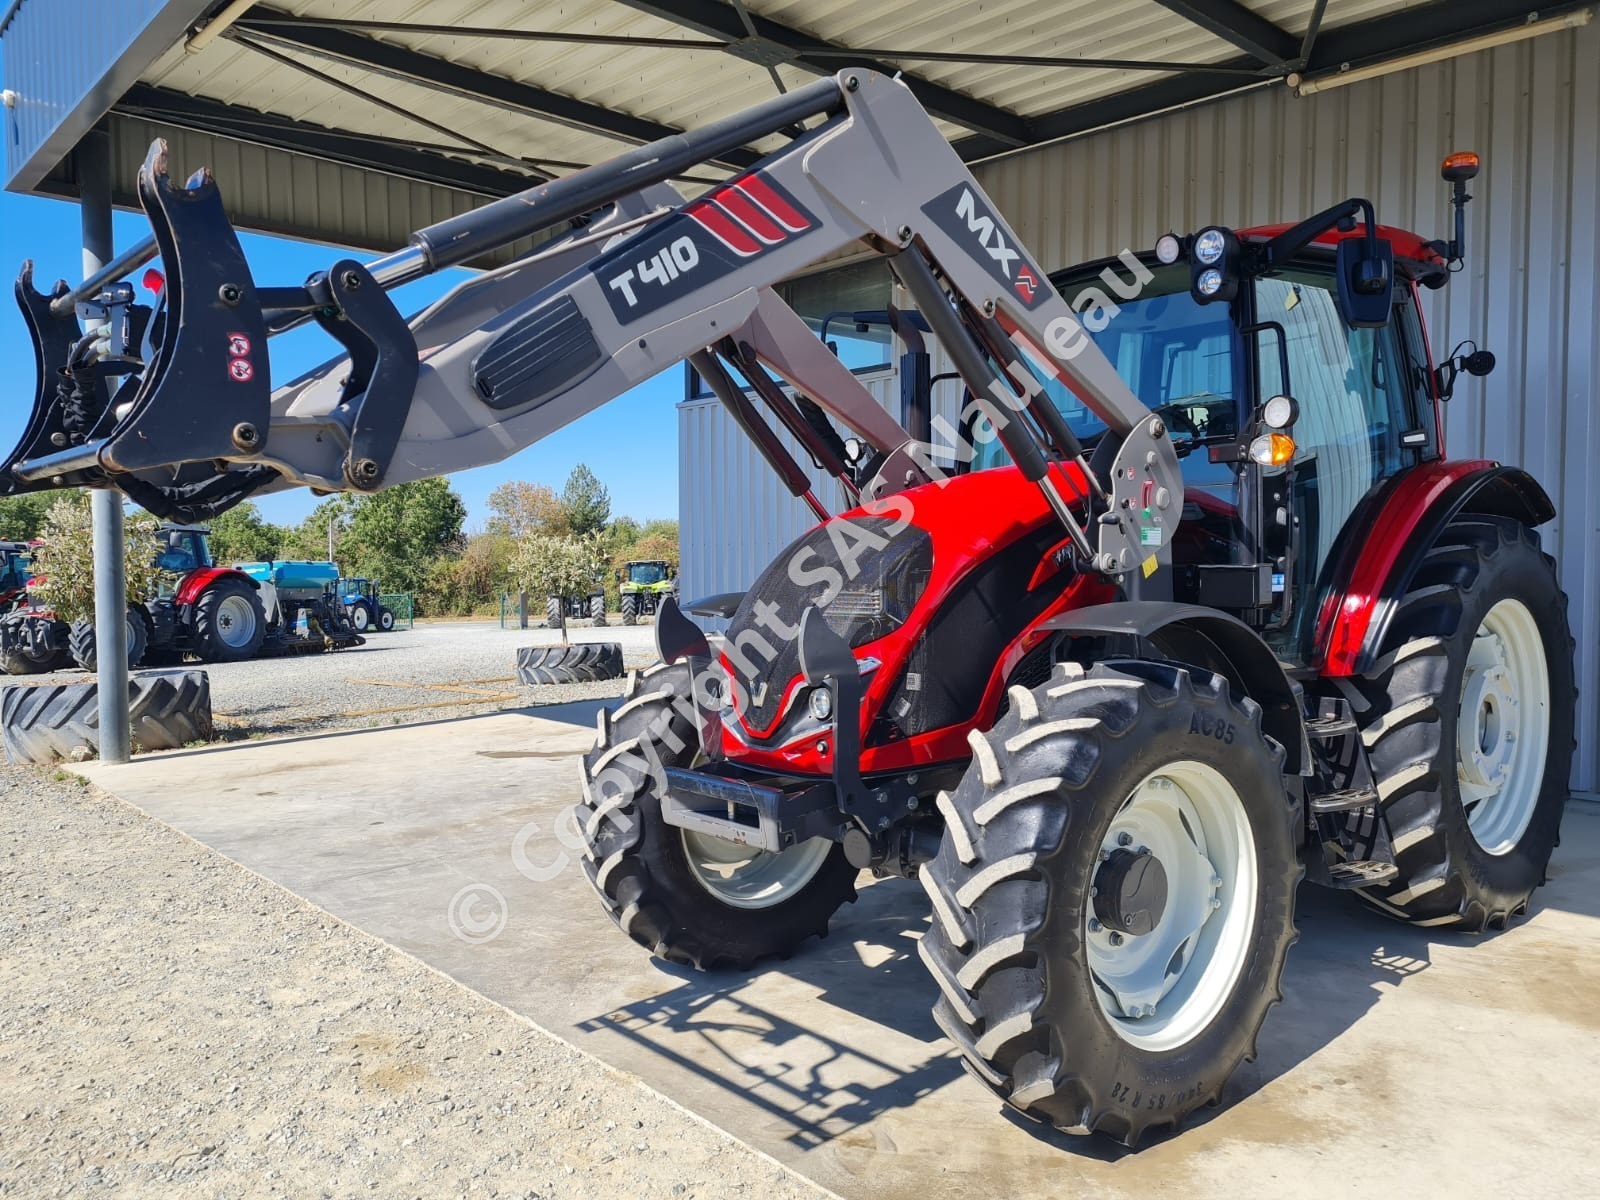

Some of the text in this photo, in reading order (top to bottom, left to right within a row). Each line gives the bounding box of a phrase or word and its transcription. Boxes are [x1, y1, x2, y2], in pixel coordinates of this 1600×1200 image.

[955, 187, 1020, 280] MX
[609, 235, 699, 307] T410
[1111, 1082, 1130, 1103] 28
